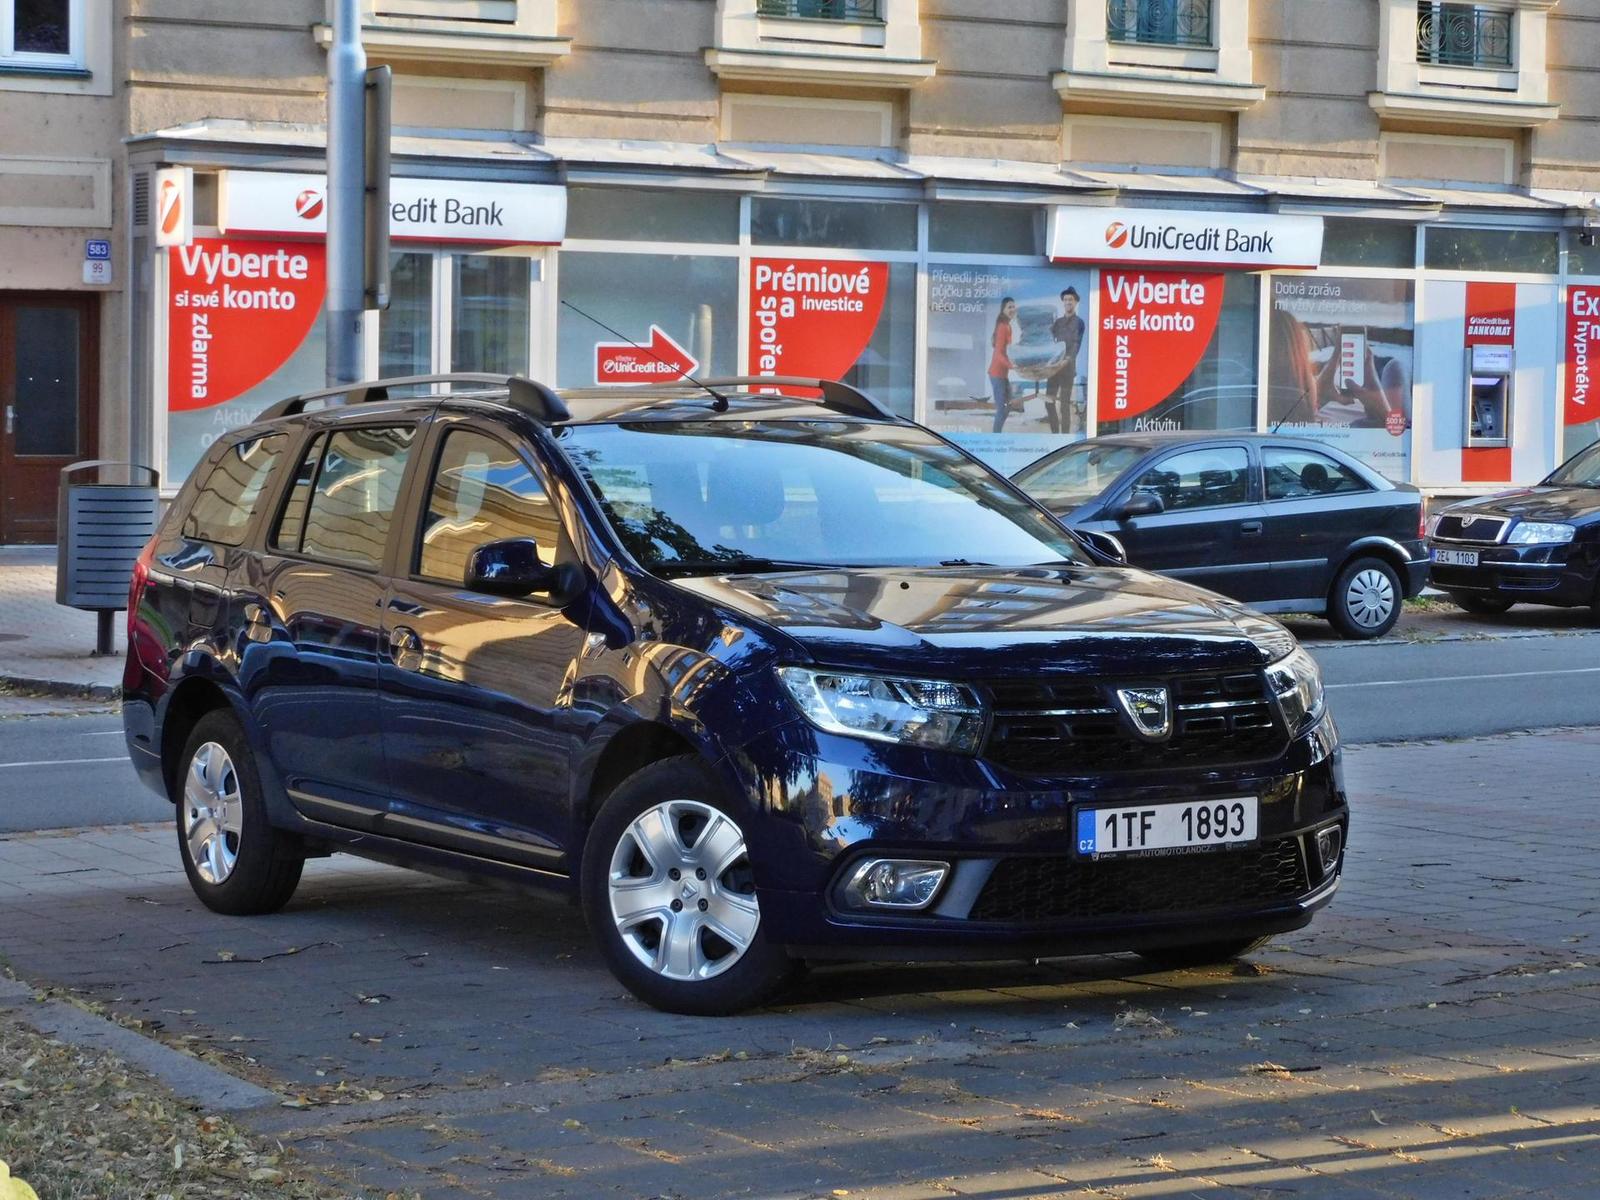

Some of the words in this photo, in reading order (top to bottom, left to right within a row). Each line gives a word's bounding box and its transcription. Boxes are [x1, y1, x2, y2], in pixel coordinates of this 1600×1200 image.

[444, 199, 503, 226] Bank
[90, 244, 107, 255] 583
[1130, 225, 1220, 251] UniCredit
[1225, 228, 1274, 253] Bank
[178, 244, 308, 285] Vyberte
[756, 264, 870, 294] Prémiové
[1275, 281, 1305, 295] Dobrá
[1308, 283, 1341, 297] zpráva
[175, 290, 189, 306] si
[191, 290, 219, 307] své
[223, 284, 295, 310] konto
[1106, 275, 1205, 310] Vyberte
[780, 296, 795, 318] a
[802, 295, 863, 312] investice
[1103, 314, 1114, 330] si
[1116, 314, 1137, 330] své
[1140, 309, 1194, 332] konto
[1467, 325, 1512, 336] BANKOMAT
[191, 313, 212, 398] zdarma
[615, 361, 656, 374] UniCredit
[657, 361, 680, 374] Bank
[1571, 320, 1591, 405] hypotéky
[1115, 335, 1131, 409] zdarma
[1436, 550, 1450, 562] 2E4
[1456, 552, 1475, 565] 1103
[1105, 810, 1156, 849] 1TF
[1181, 802, 1245, 842] 1893
[1079, 838, 1094, 850] CZ
